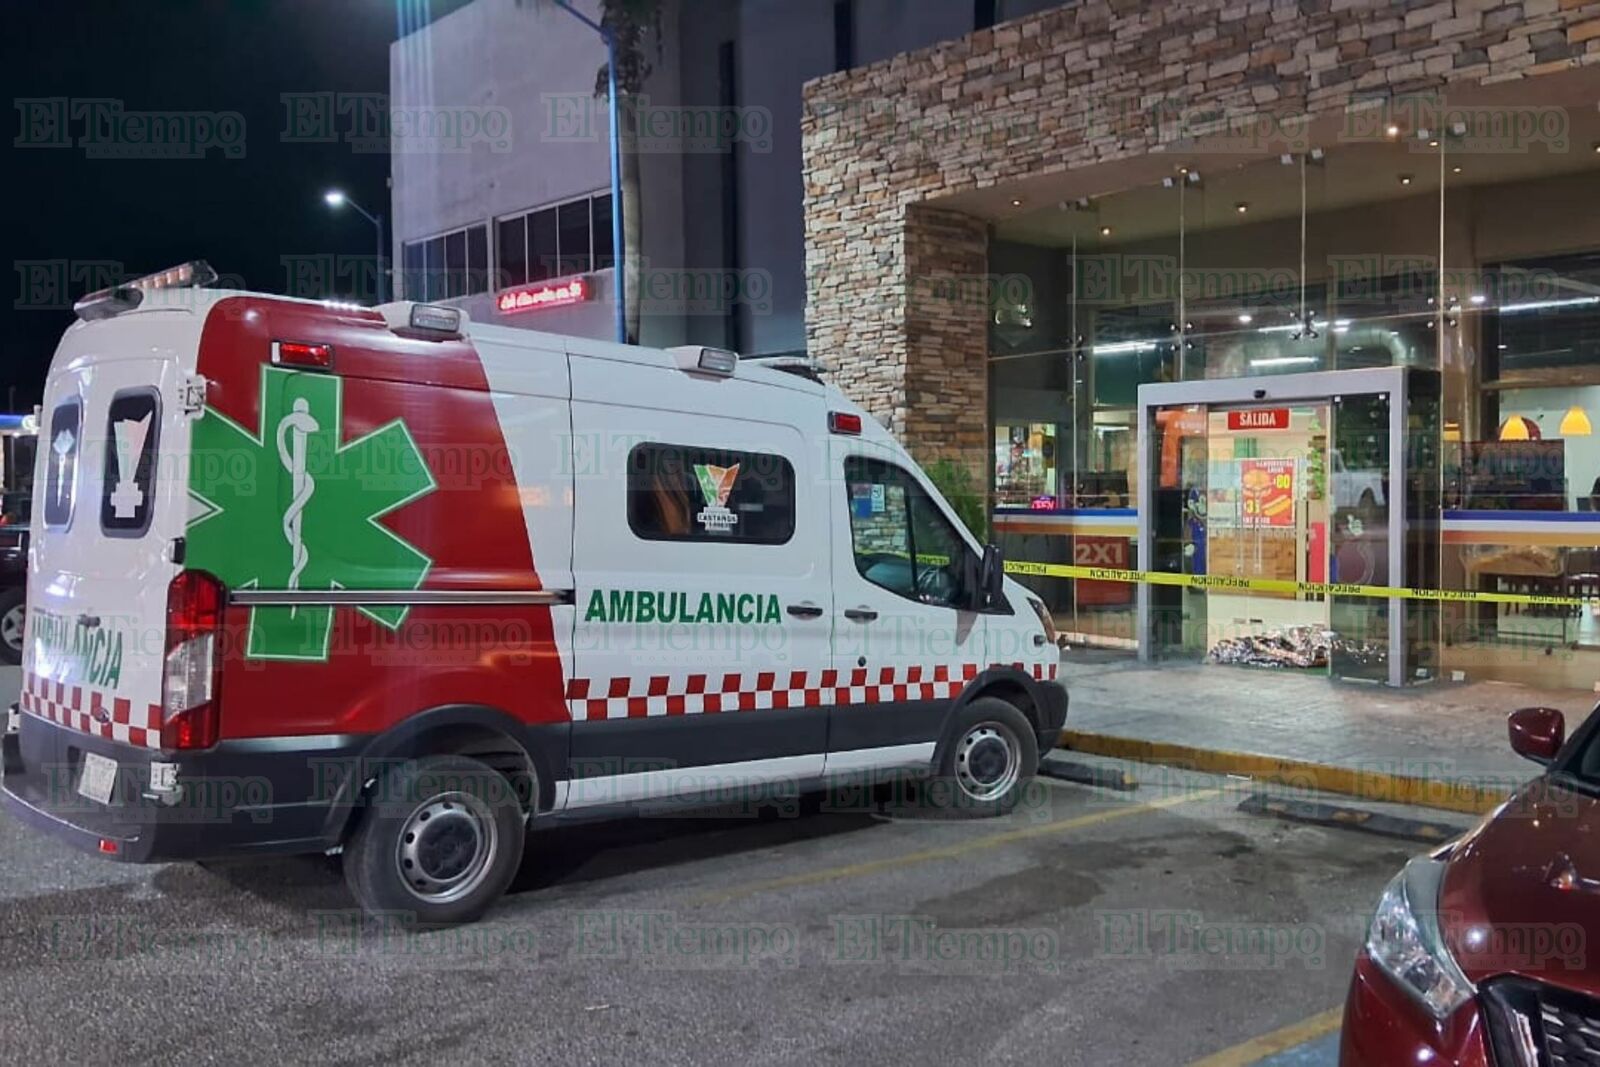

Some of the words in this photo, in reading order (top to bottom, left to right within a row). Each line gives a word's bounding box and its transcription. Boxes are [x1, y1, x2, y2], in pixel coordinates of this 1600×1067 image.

[1239, 412, 1277, 427] SALIDA
[1076, 542, 1124, 564] 2X1
[1090, 569, 1147, 581] PRECAUCION
[1190, 576, 1251, 589] PRECAUCION
[1298, 583, 1362, 594] PRECAUCION
[1411, 588, 1477, 600] PRECAUCION
[584, 589, 782, 624] AMBULANCIA
